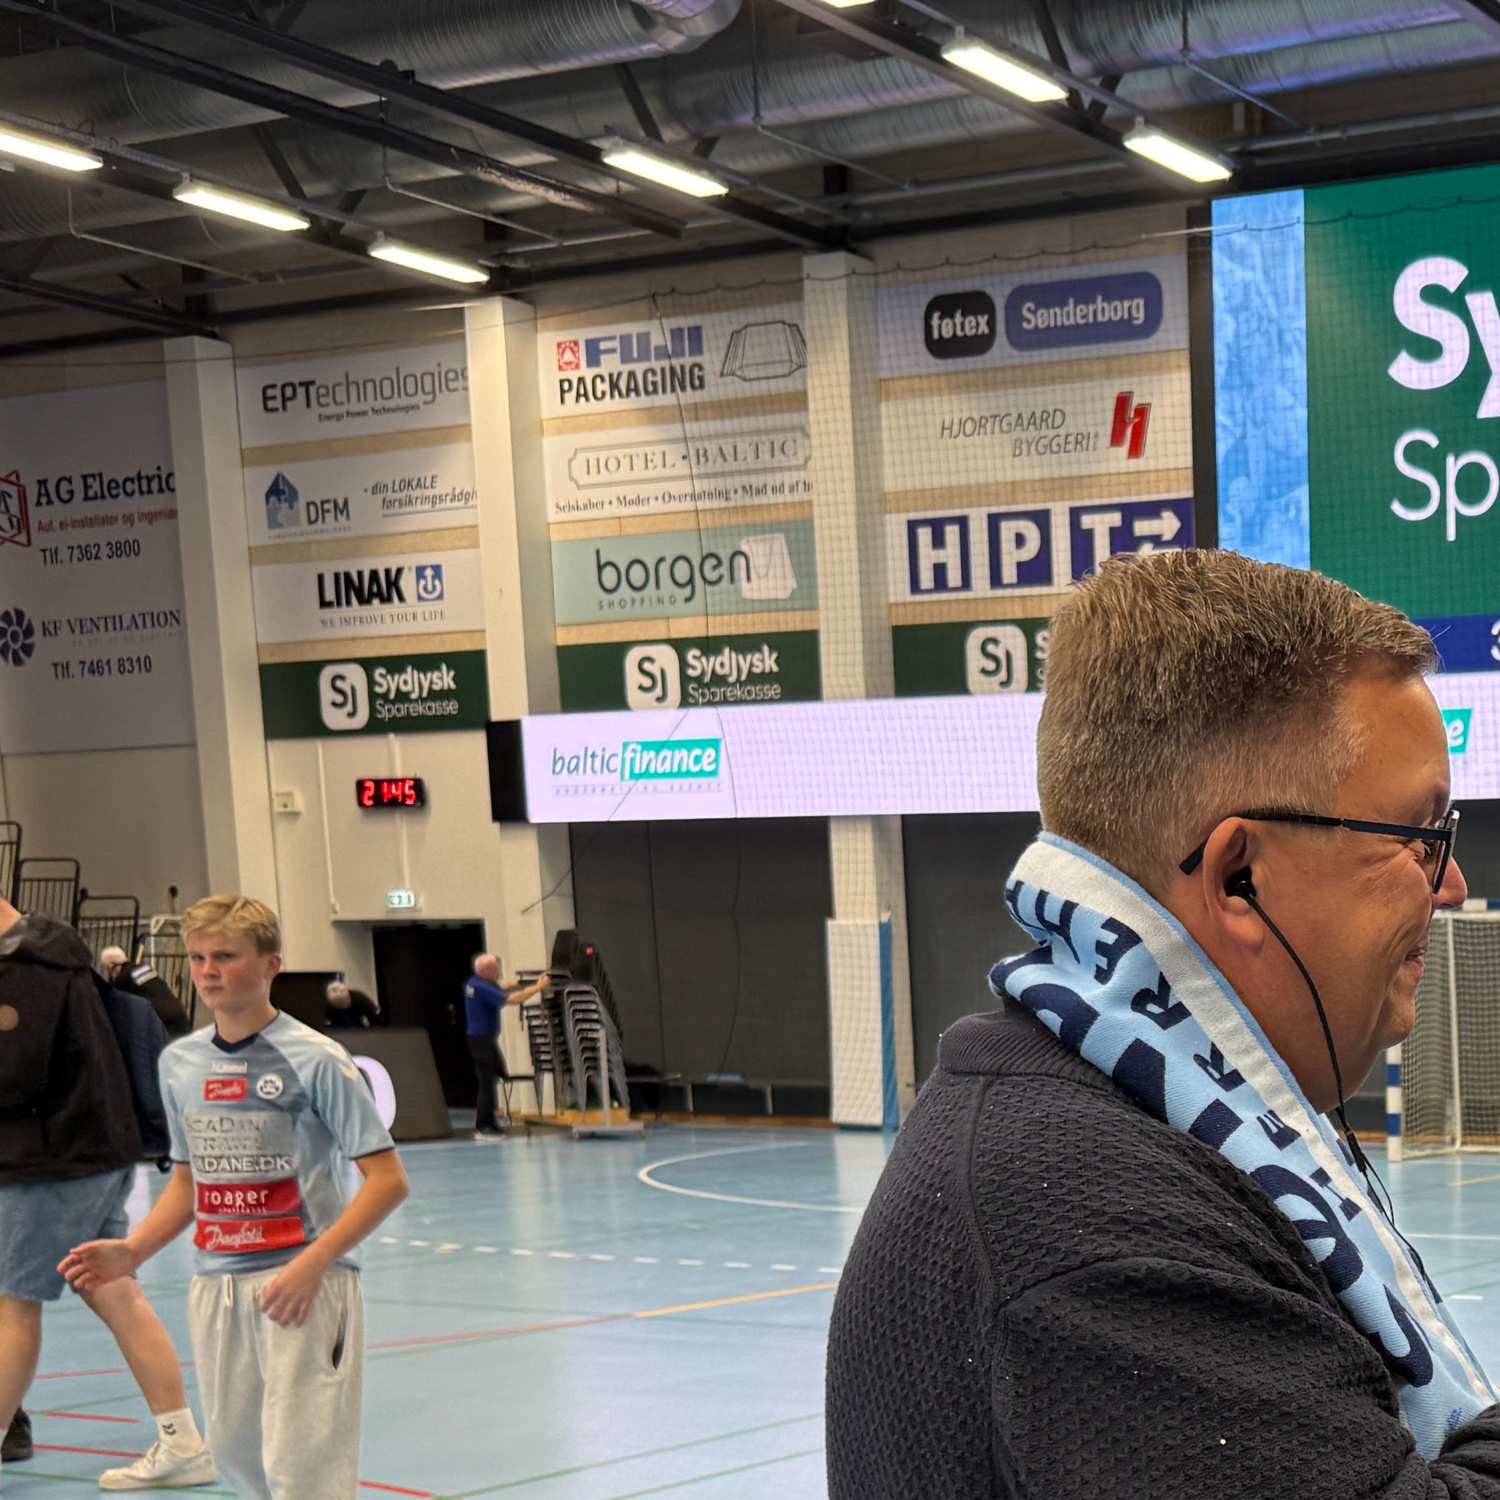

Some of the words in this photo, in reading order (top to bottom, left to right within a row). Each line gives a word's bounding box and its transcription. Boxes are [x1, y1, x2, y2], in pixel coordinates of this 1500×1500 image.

[930, 309, 990, 340] føtex
[1022, 295, 1145, 331] Sønderborg
[585, 325, 704, 369] FUJI
[559, 363, 706, 405] PACKAGING
[941, 408, 1066, 439] HJORTGAARD
[585, 450, 676, 476] HOTEL
[696, 439, 798, 466] BALTIC
[1013, 432, 1091, 458] BYGGERI
[35, 476, 74, 507] AG
[81, 465, 175, 501] Electric
[391, 475, 438, 493] LOKALE
[306, 497, 350, 525] DFM
[40, 548, 63, 565] Tlf.
[68, 543, 101, 563] 7362
[107, 538, 140, 559] 3800
[317, 566, 407, 609] LINAK
[595, 548, 752, 603] borgen
[67, 609, 181, 636] VENTILATION
[118, 654, 152, 674] 8310
[686, 644, 779, 683] Sydjysk
[374, 662, 457, 700] Sydjysk
[687, 683, 781, 705] Sparekasse
[375, 698, 459, 721] Sparekasse
[552, 746, 619, 775] baltic
[622, 743, 717, 781] finance
